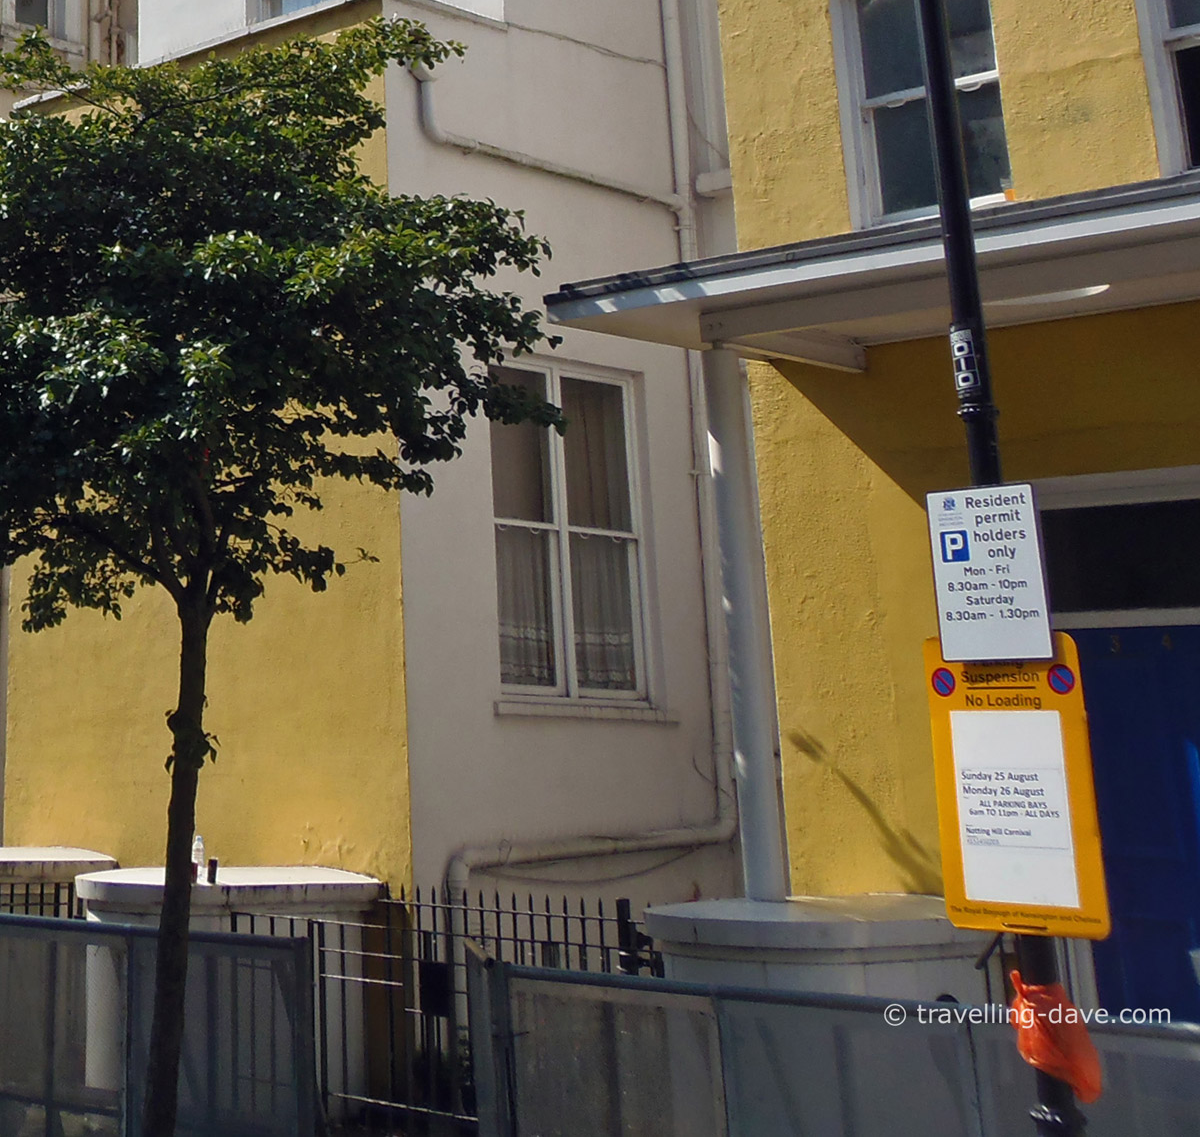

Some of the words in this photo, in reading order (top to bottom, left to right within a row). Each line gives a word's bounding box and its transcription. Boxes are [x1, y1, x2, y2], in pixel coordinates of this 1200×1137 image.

[964, 492, 1026, 509] Resident
[975, 509, 1021, 527] permit
[974, 528, 1026, 543] holders
[987, 545, 1016, 559] only
[964, 566, 986, 577] Mon
[995, 564, 1010, 575] Fri
[947, 581, 988, 592] 8.30am
[998, 579, 1028, 591] 10pm
[966, 594, 1015, 606] Saturday
[946, 610, 987, 622] 8.30am
[999, 608, 1040, 620] 1.30pm
[961, 671, 1040, 685] Suspension
[965, 695, 983, 707] No
[986, 694, 1042, 709] Loading
[961, 771, 992, 781] Sunday
[994, 772, 1005, 781] 25
[1007, 772, 1039, 783] August
[962, 786, 998, 796] Monday
[1000, 787, 1011, 795] 26
[1013, 787, 1045, 798] August
[993, 800, 1026, 809] PARKING
[1028, 801, 1048, 809] BAYS
[1025, 810, 1038, 818] ALL
[1040, 810, 1060, 818] DAYS
